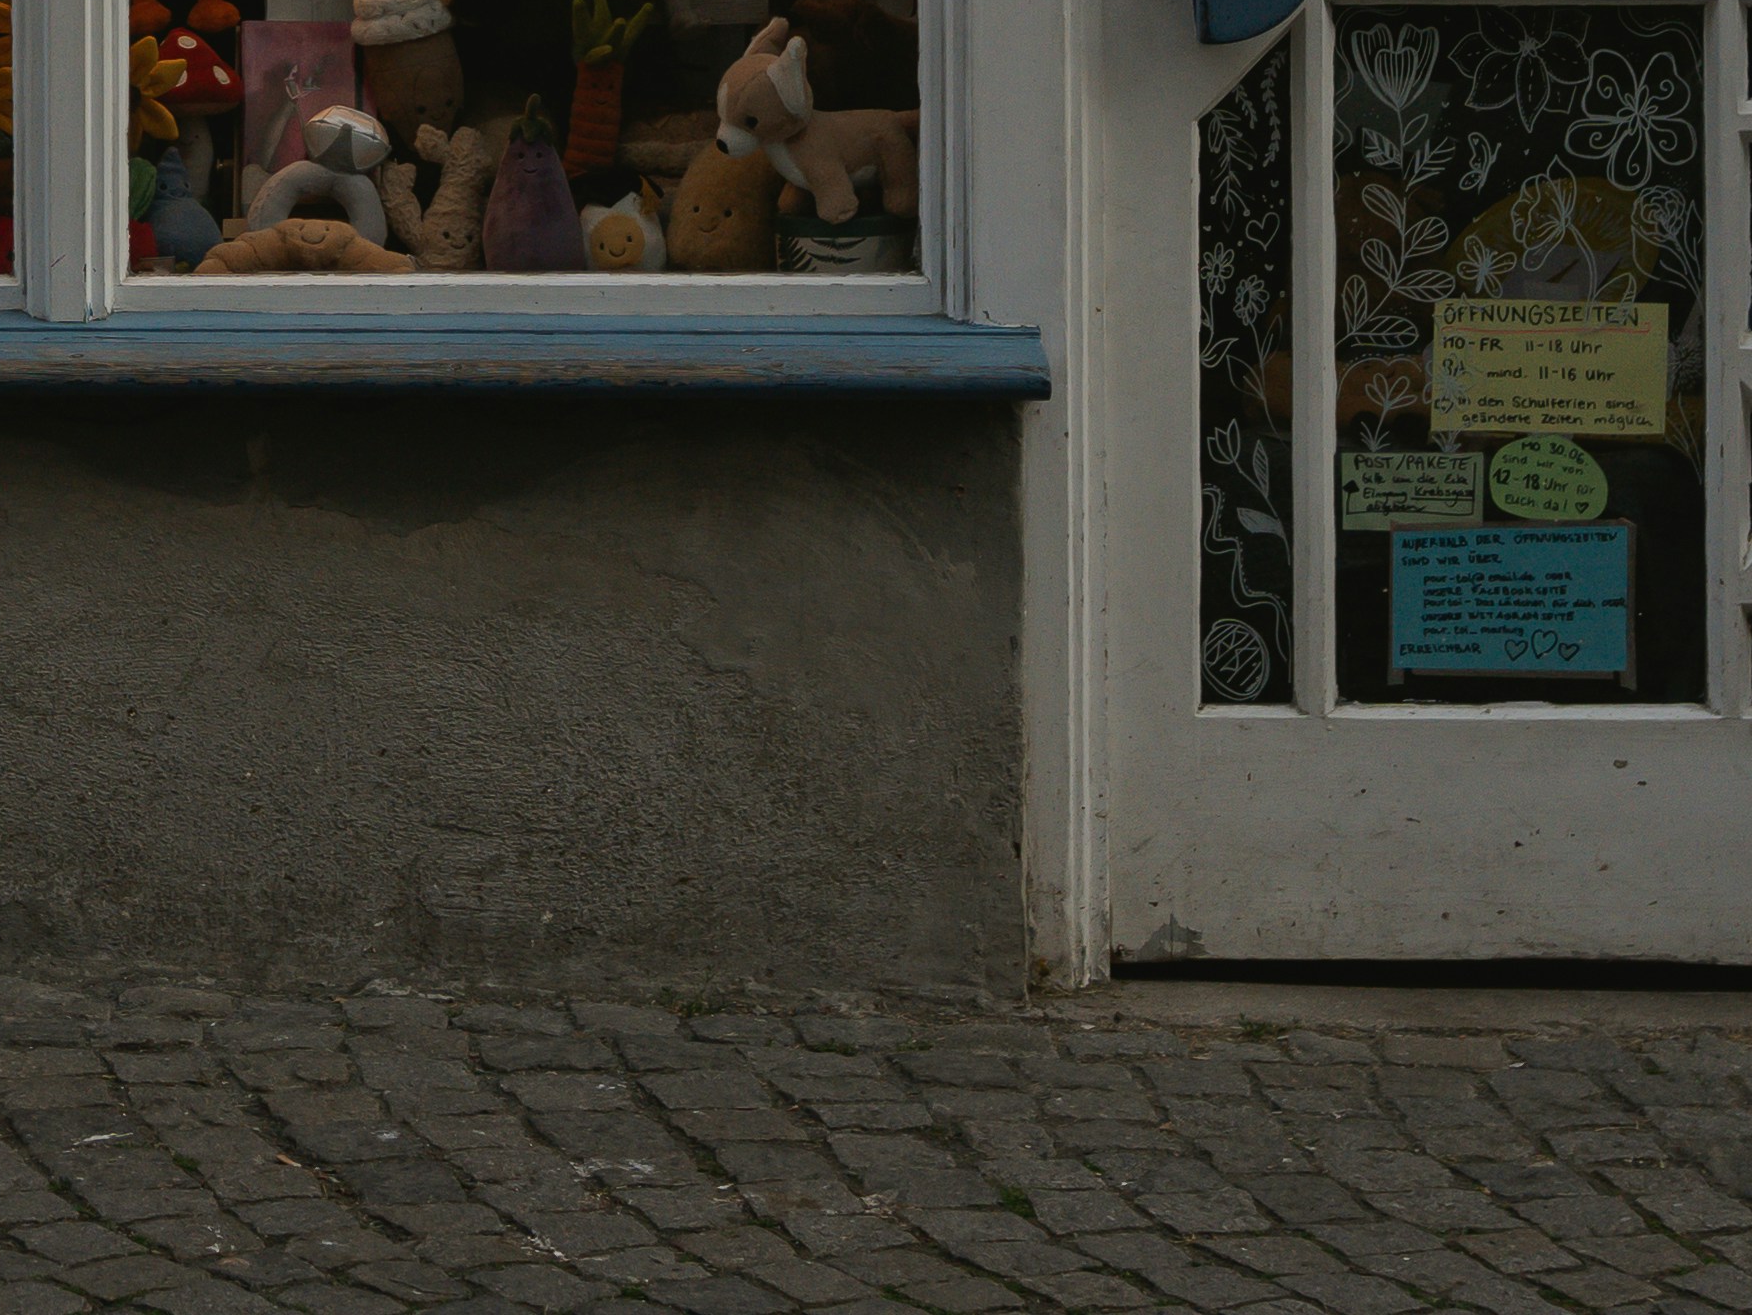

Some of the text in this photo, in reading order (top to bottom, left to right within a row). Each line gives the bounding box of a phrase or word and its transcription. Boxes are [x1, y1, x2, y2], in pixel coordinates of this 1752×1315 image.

[1570, 339, 1602, 354] Uhr
[1477, 396, 1504, 406] den
[1512, 395, 1596, 409] Schulferien
[1462, 412, 1531, 427] geänderte
[1594, 414, 1653, 430] möglich
[1521, 441, 1541, 451] MO
[1562, 466, 1584, 476] von
[1417, 472, 1437, 483] die
[1544, 477, 1569, 492] Uhr
[1476, 534, 1505, 545] DER
[1401, 555, 1430, 566] SIND
[1436, 555, 1460, 565] WIR
[1399, 642, 1482, 656] ERREICHBAR
